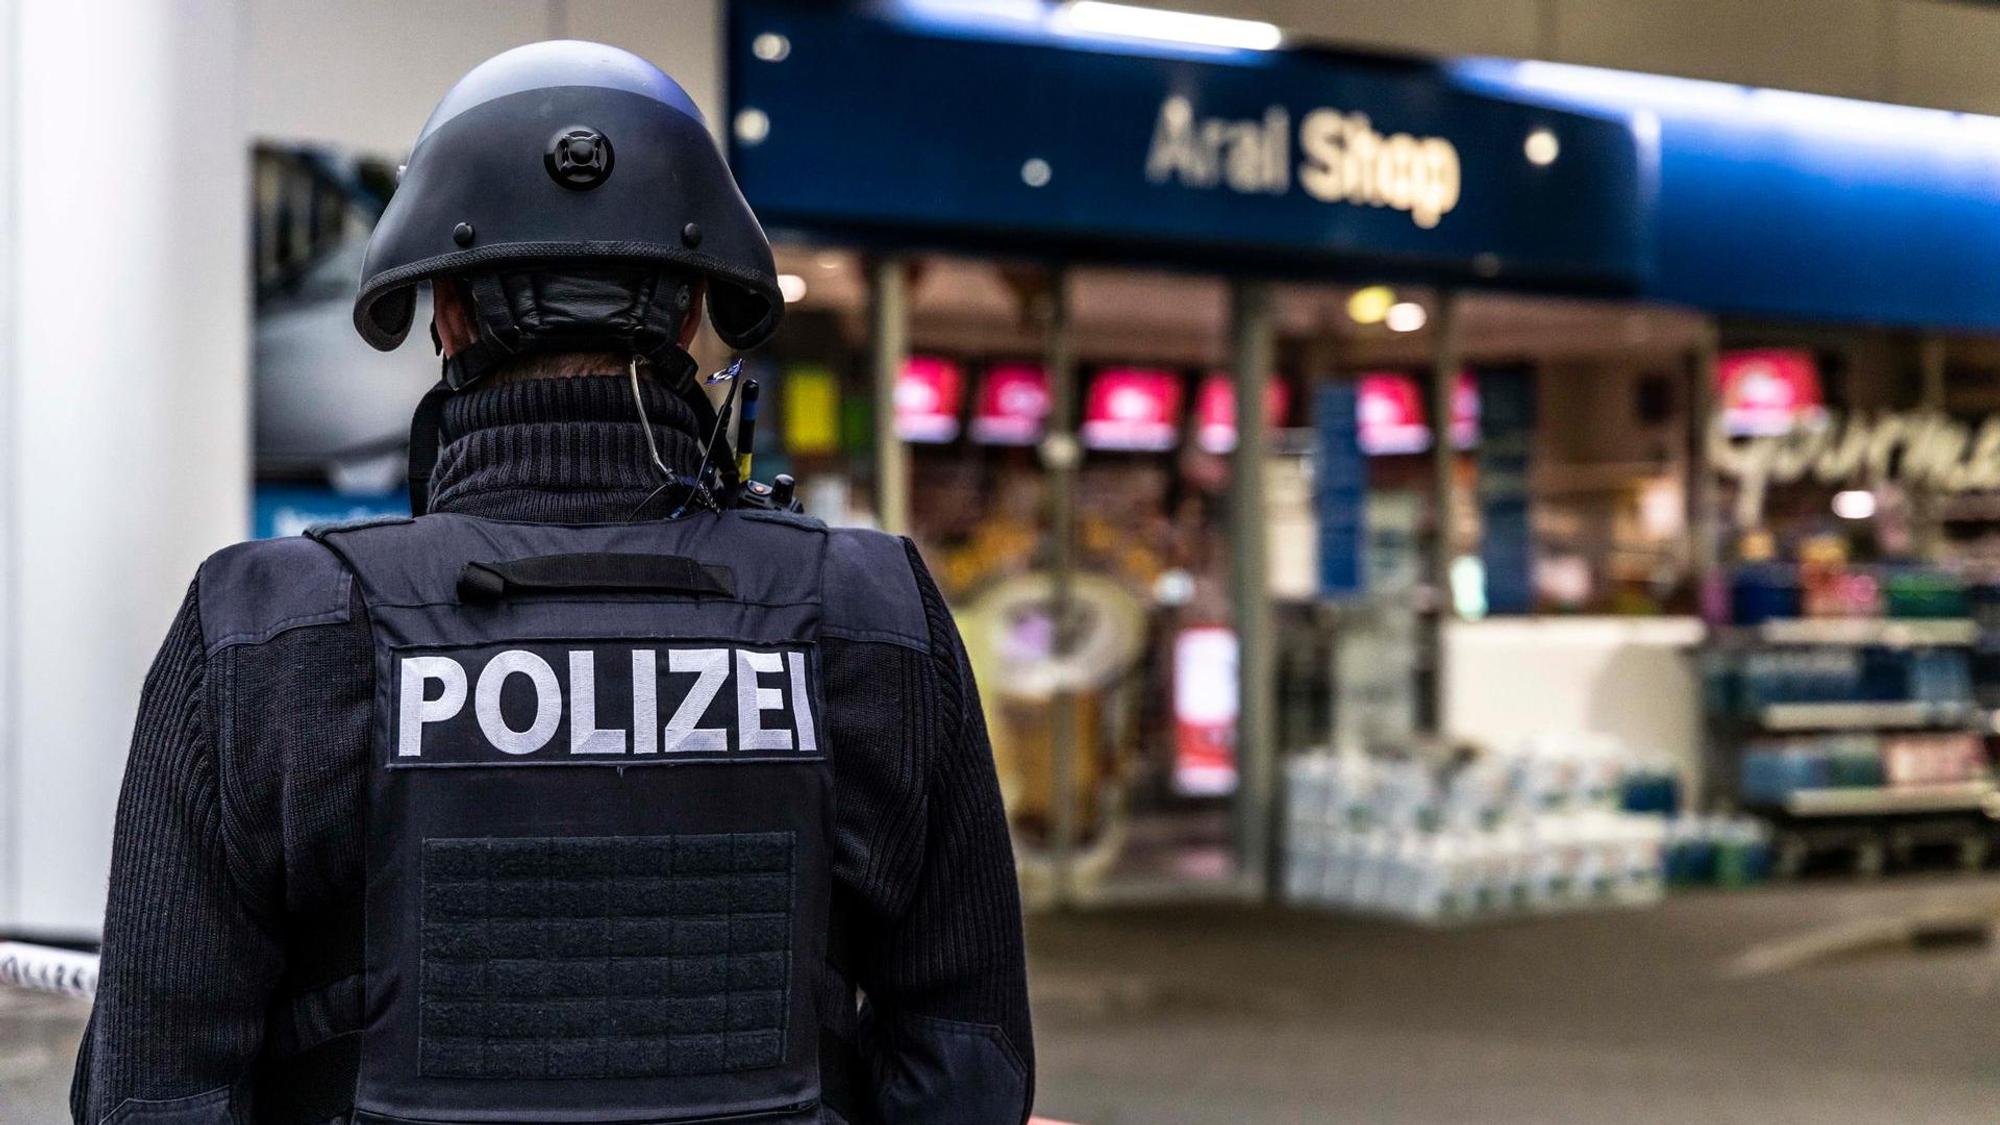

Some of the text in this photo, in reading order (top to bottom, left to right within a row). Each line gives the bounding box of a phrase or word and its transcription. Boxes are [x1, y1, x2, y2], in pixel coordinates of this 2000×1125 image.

[1146, 96, 1460, 229] Aral Shop
[398, 648, 817, 757] POLIZEI
